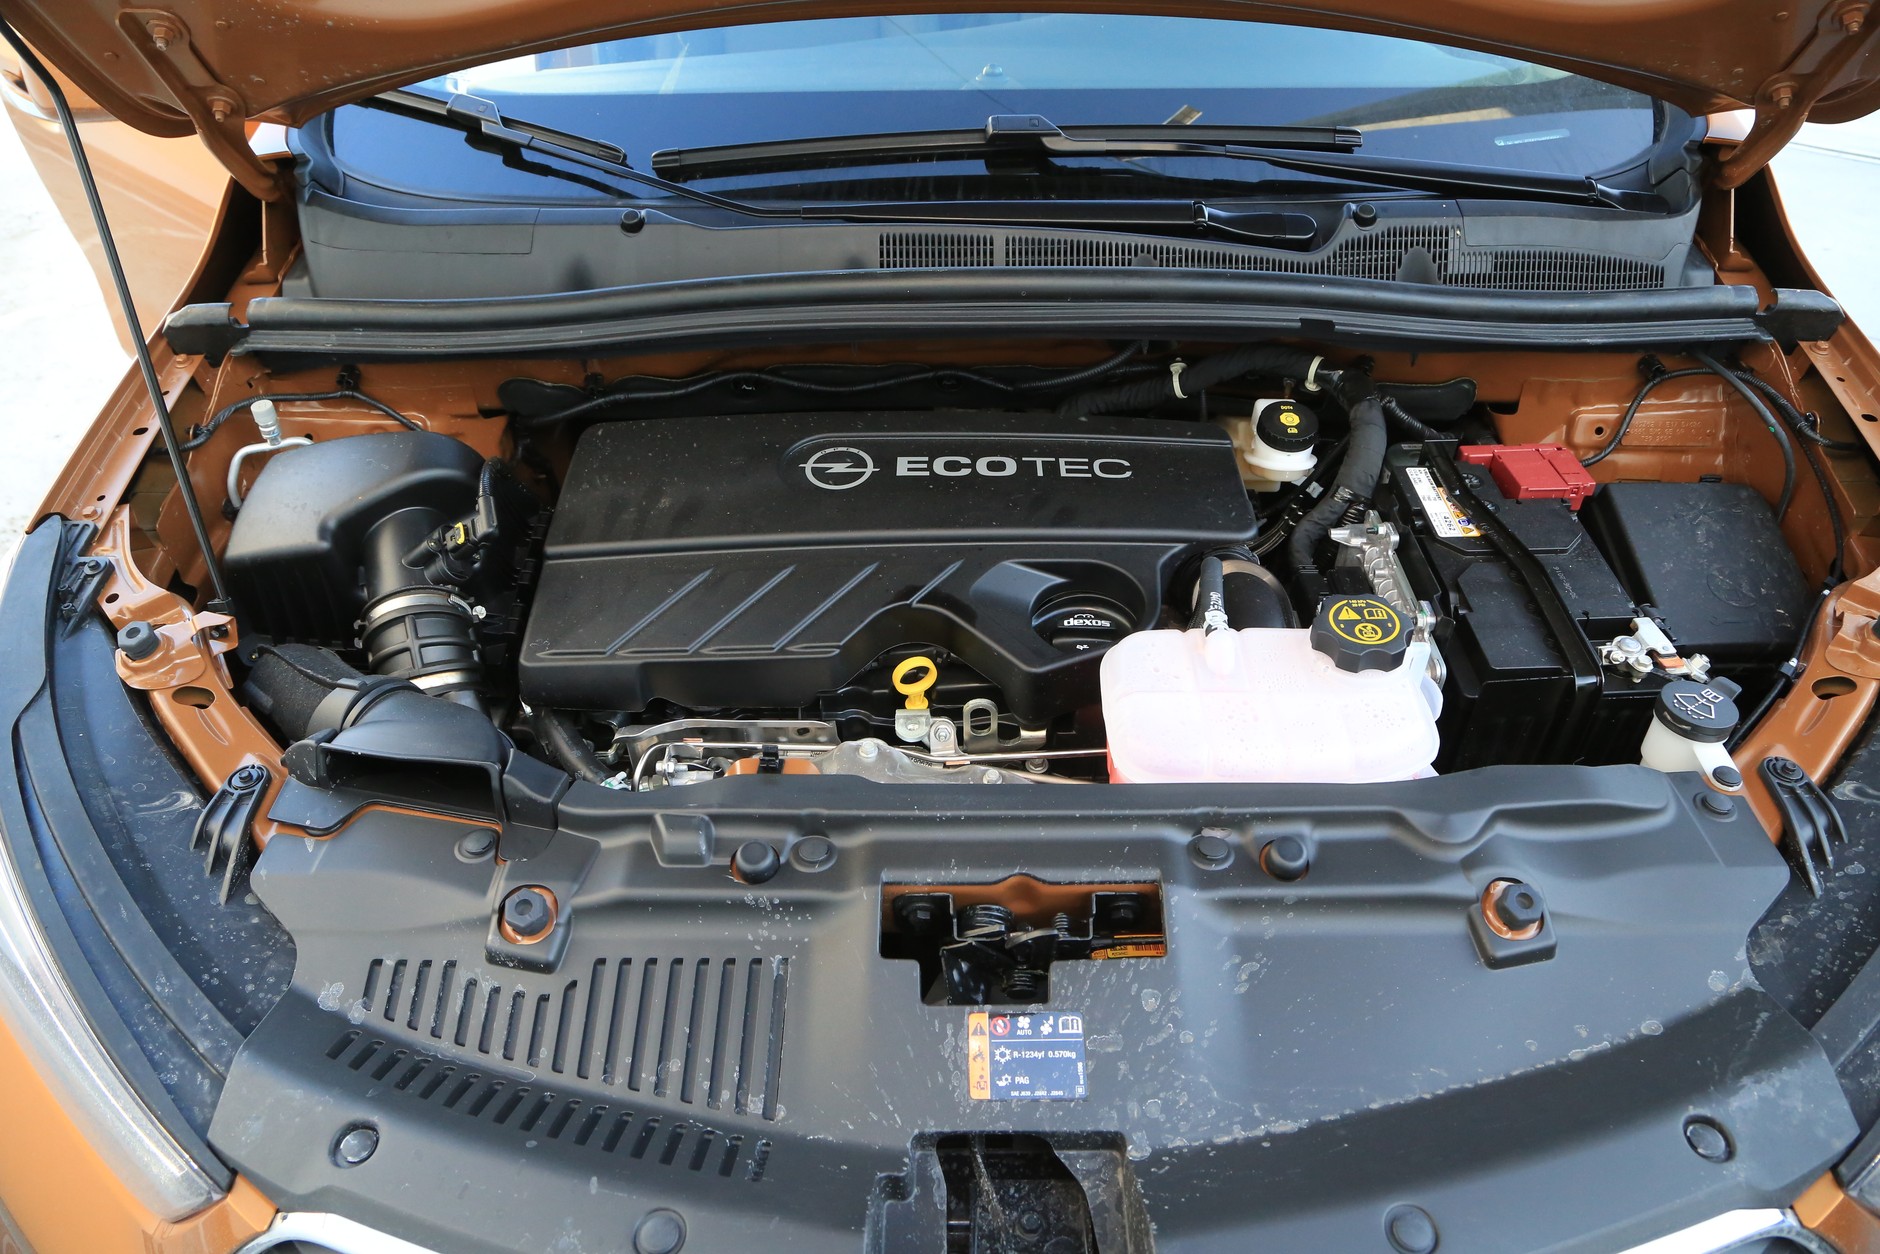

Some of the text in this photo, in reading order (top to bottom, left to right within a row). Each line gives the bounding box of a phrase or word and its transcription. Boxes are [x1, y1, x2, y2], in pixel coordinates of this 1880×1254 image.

[896, 456, 1133, 479] ECOTEC
[1063, 618, 1111, 627] dexos
[1013, 1051, 1076, 1059] R-1234yf 0.570kg
[1015, 1076, 1030, 1085] PAG
